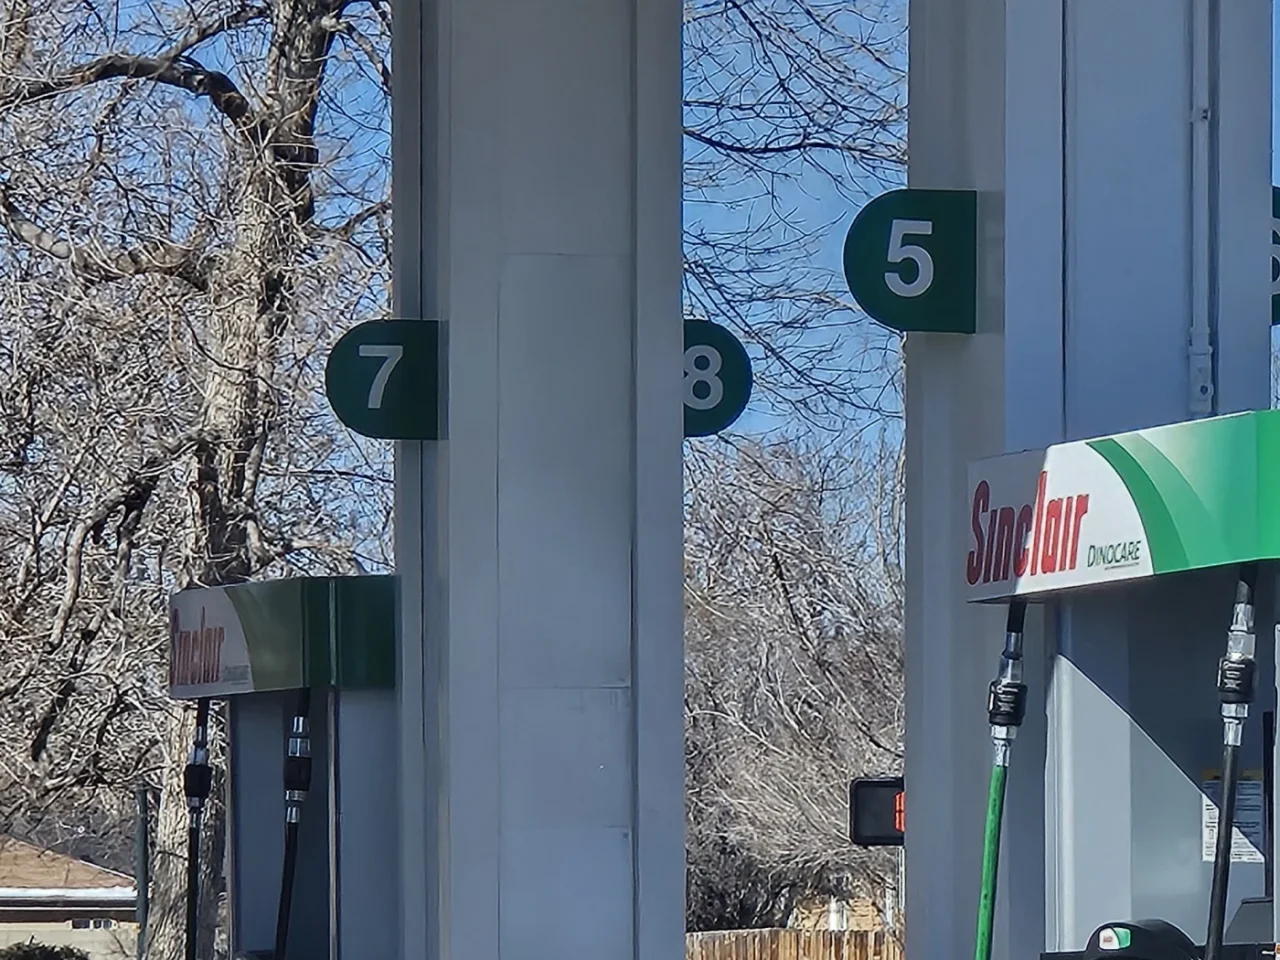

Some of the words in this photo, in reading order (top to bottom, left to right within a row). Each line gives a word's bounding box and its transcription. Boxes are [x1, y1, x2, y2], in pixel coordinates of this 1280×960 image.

[884, 218, 934, 297] 5
[358, 344, 404, 409] 7
[683, 345, 723, 410] 8
[966, 470, 1089, 586] Sinclair
[1087, 540, 1142, 568] DINOCARE
